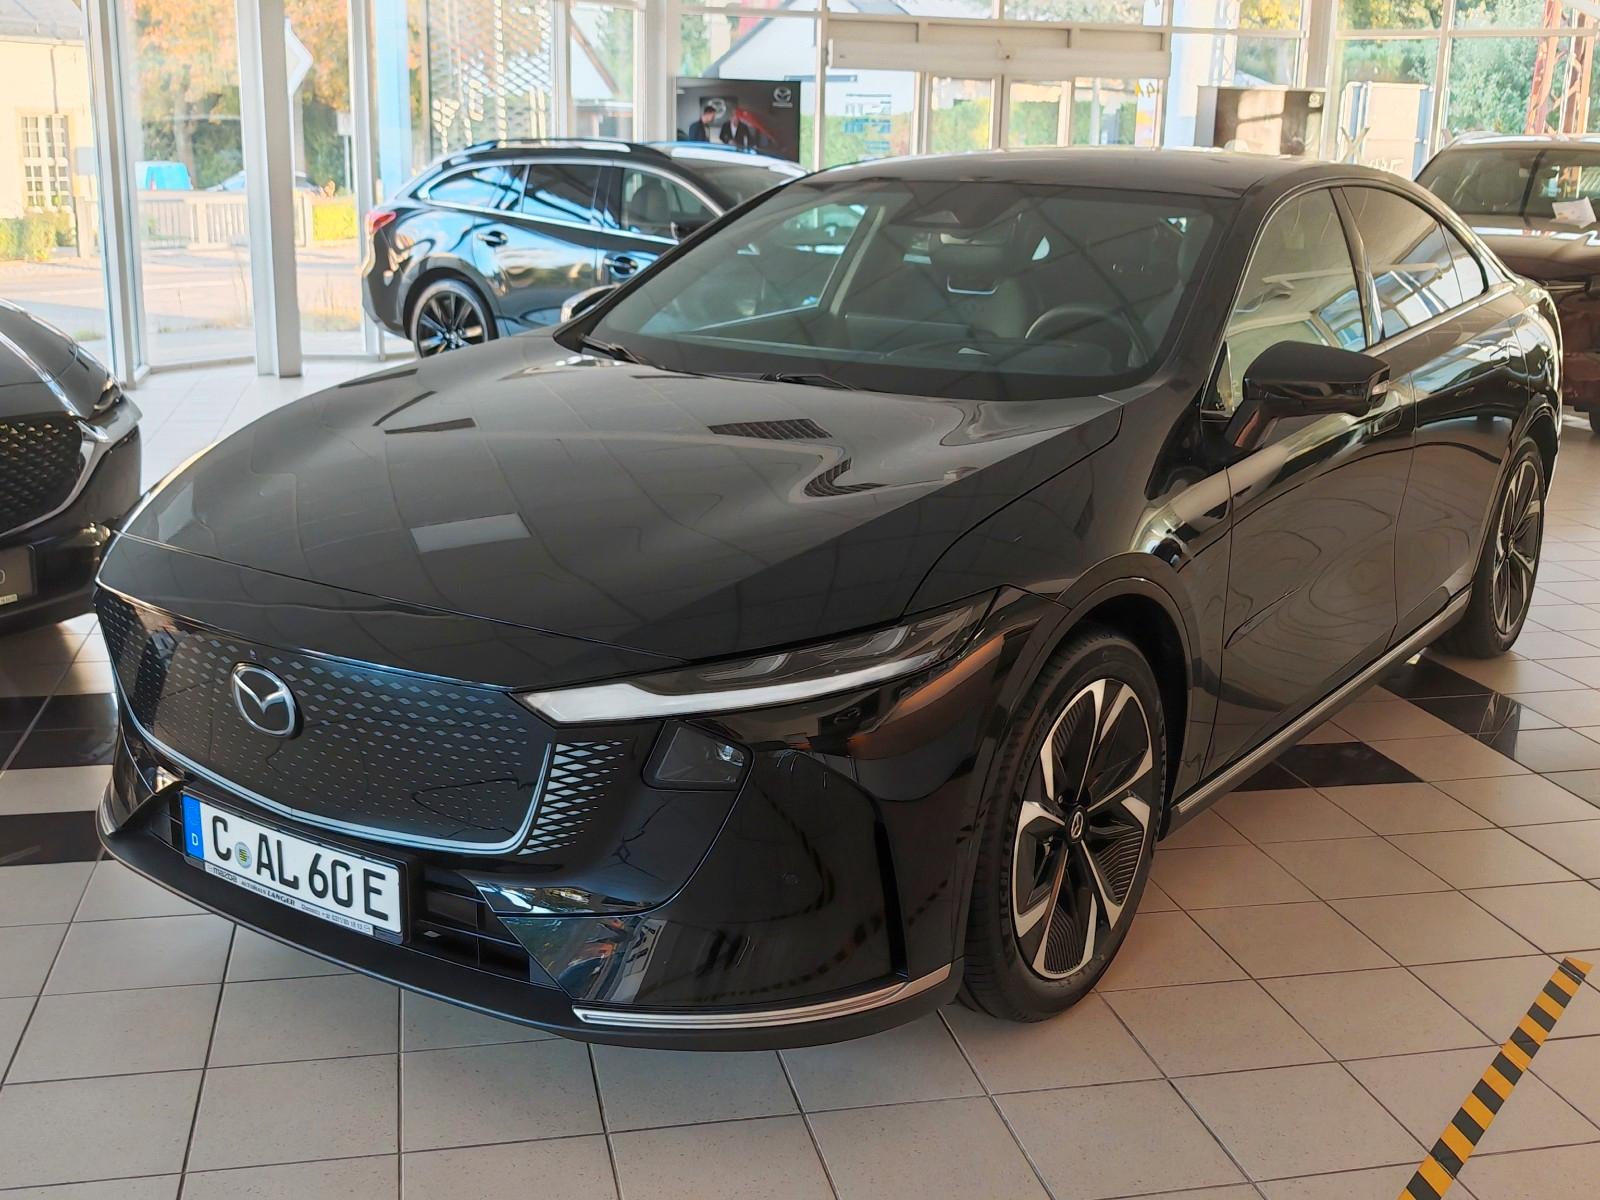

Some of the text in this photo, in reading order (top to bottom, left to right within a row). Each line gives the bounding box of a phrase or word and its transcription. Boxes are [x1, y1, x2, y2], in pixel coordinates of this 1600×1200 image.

[191, 832, 199, 846] D
[212, 815, 232, 861] C
[256, 833, 300, 890] AL
[267, 889, 296, 907] LANGER
